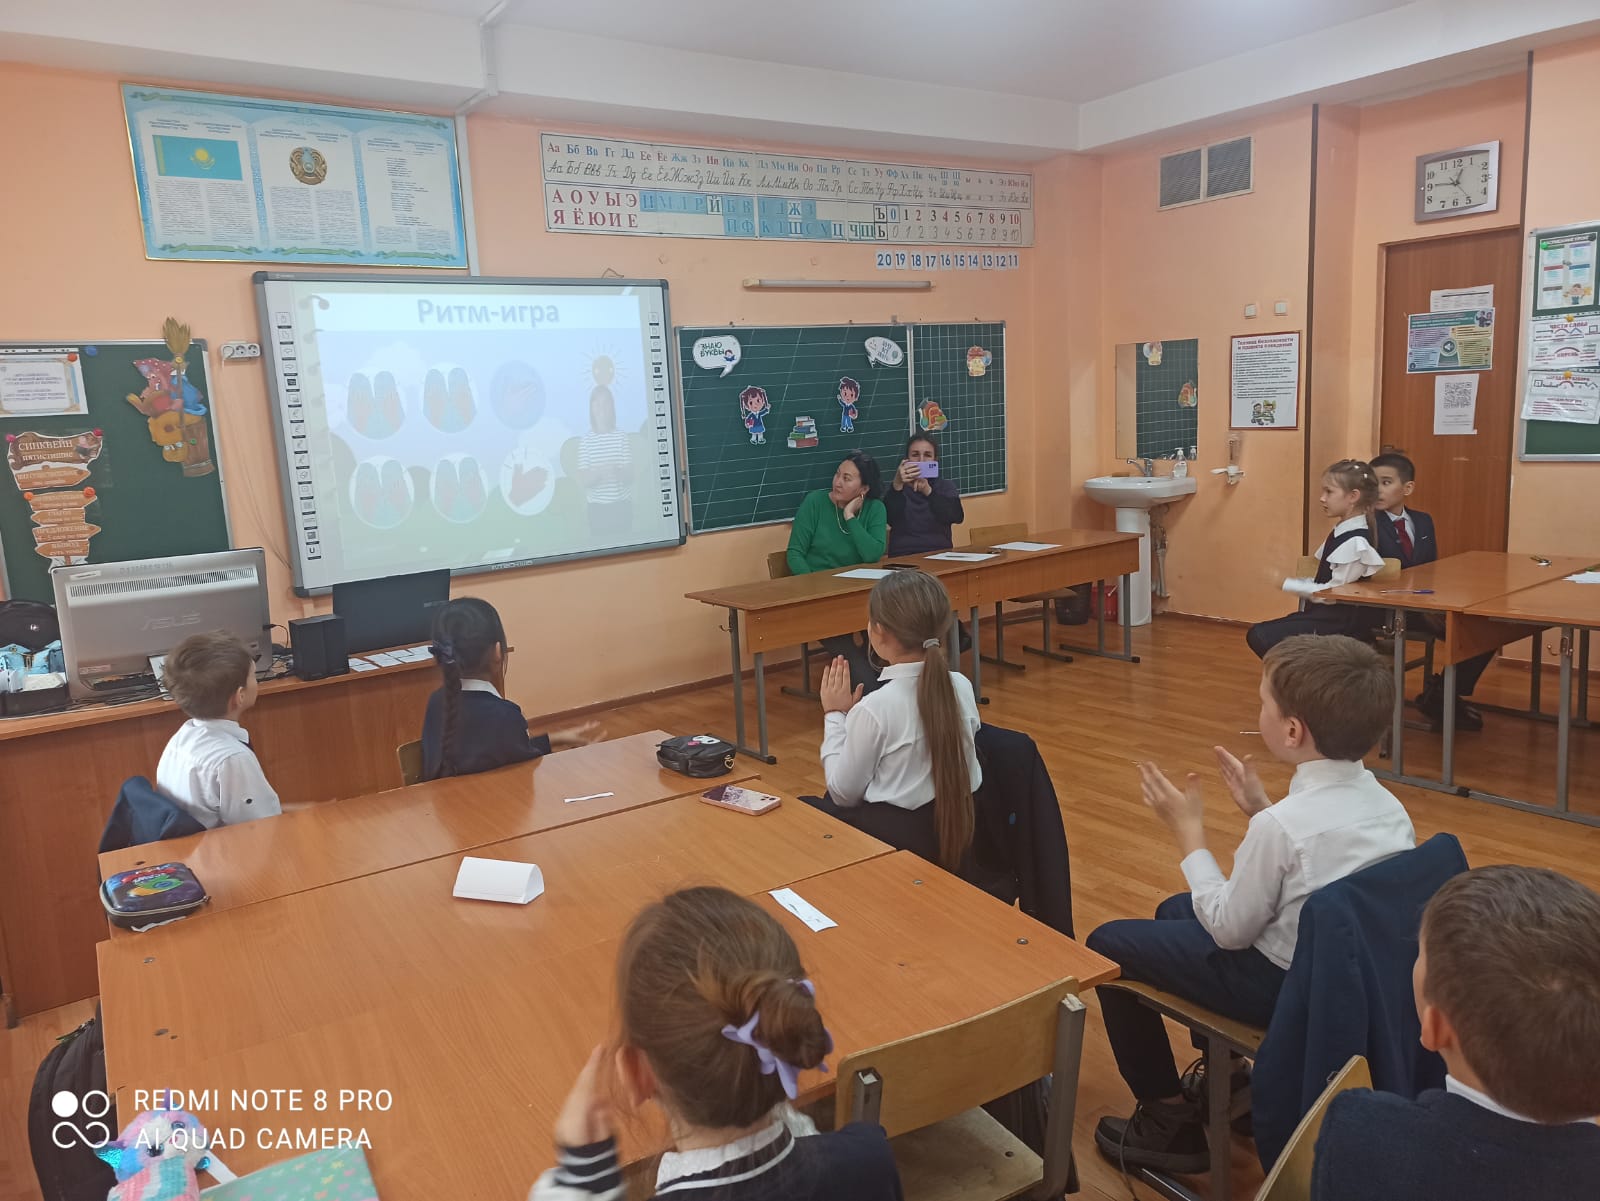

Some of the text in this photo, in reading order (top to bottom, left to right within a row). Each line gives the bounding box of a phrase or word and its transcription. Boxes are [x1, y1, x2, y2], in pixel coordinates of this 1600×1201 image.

[547, 142, 560, 153] Аа
[567, 144, 580, 154] Бб
[1452, 158, 1463, 168] 12
[1470, 157, 1473, 165] 1
[1440, 162, 1448, 170] 11
[1481, 162, 1488, 170] 2
[1427, 172, 1435, 180] 10
[1481, 174, 1488, 183] 3
[1427, 184, 1433, 192] 9
[1481, 187, 1486, 195] 4
[552, 188, 564, 204] А
[570, 190, 583, 204] О
[588, 190, 600, 206] У
[606, 192, 621, 208] Ы
[626, 194, 638, 207] Э
[710, 196, 721, 213] Й
[788, 202, 802, 216] Ж
[1426, 196, 1432, 204] 8
[1440, 200, 1446, 208] 7
[1452, 198, 1458, 206] 6
[1466, 196, 1472, 204] 5
[890, 207, 1020, 224] 0 1 2 3 4 5 6 7 8 9 10
[554, 210, 566, 224] Я
[573, 208, 585, 226] Ё
[588, 212, 606, 226] Ю
[608, 212, 622, 227] И
[628, 214, 638, 228] Е
[850, 222, 859, 236] Ч
[877, 253, 1018, 267] 20 19 18 17 16 15 14 13 12 11
[417, 299, 560, 328] Ритм-игра
[700, 342, 722, 350] ЗНАЮ
[700, 348, 725, 358] БУКВЫ
